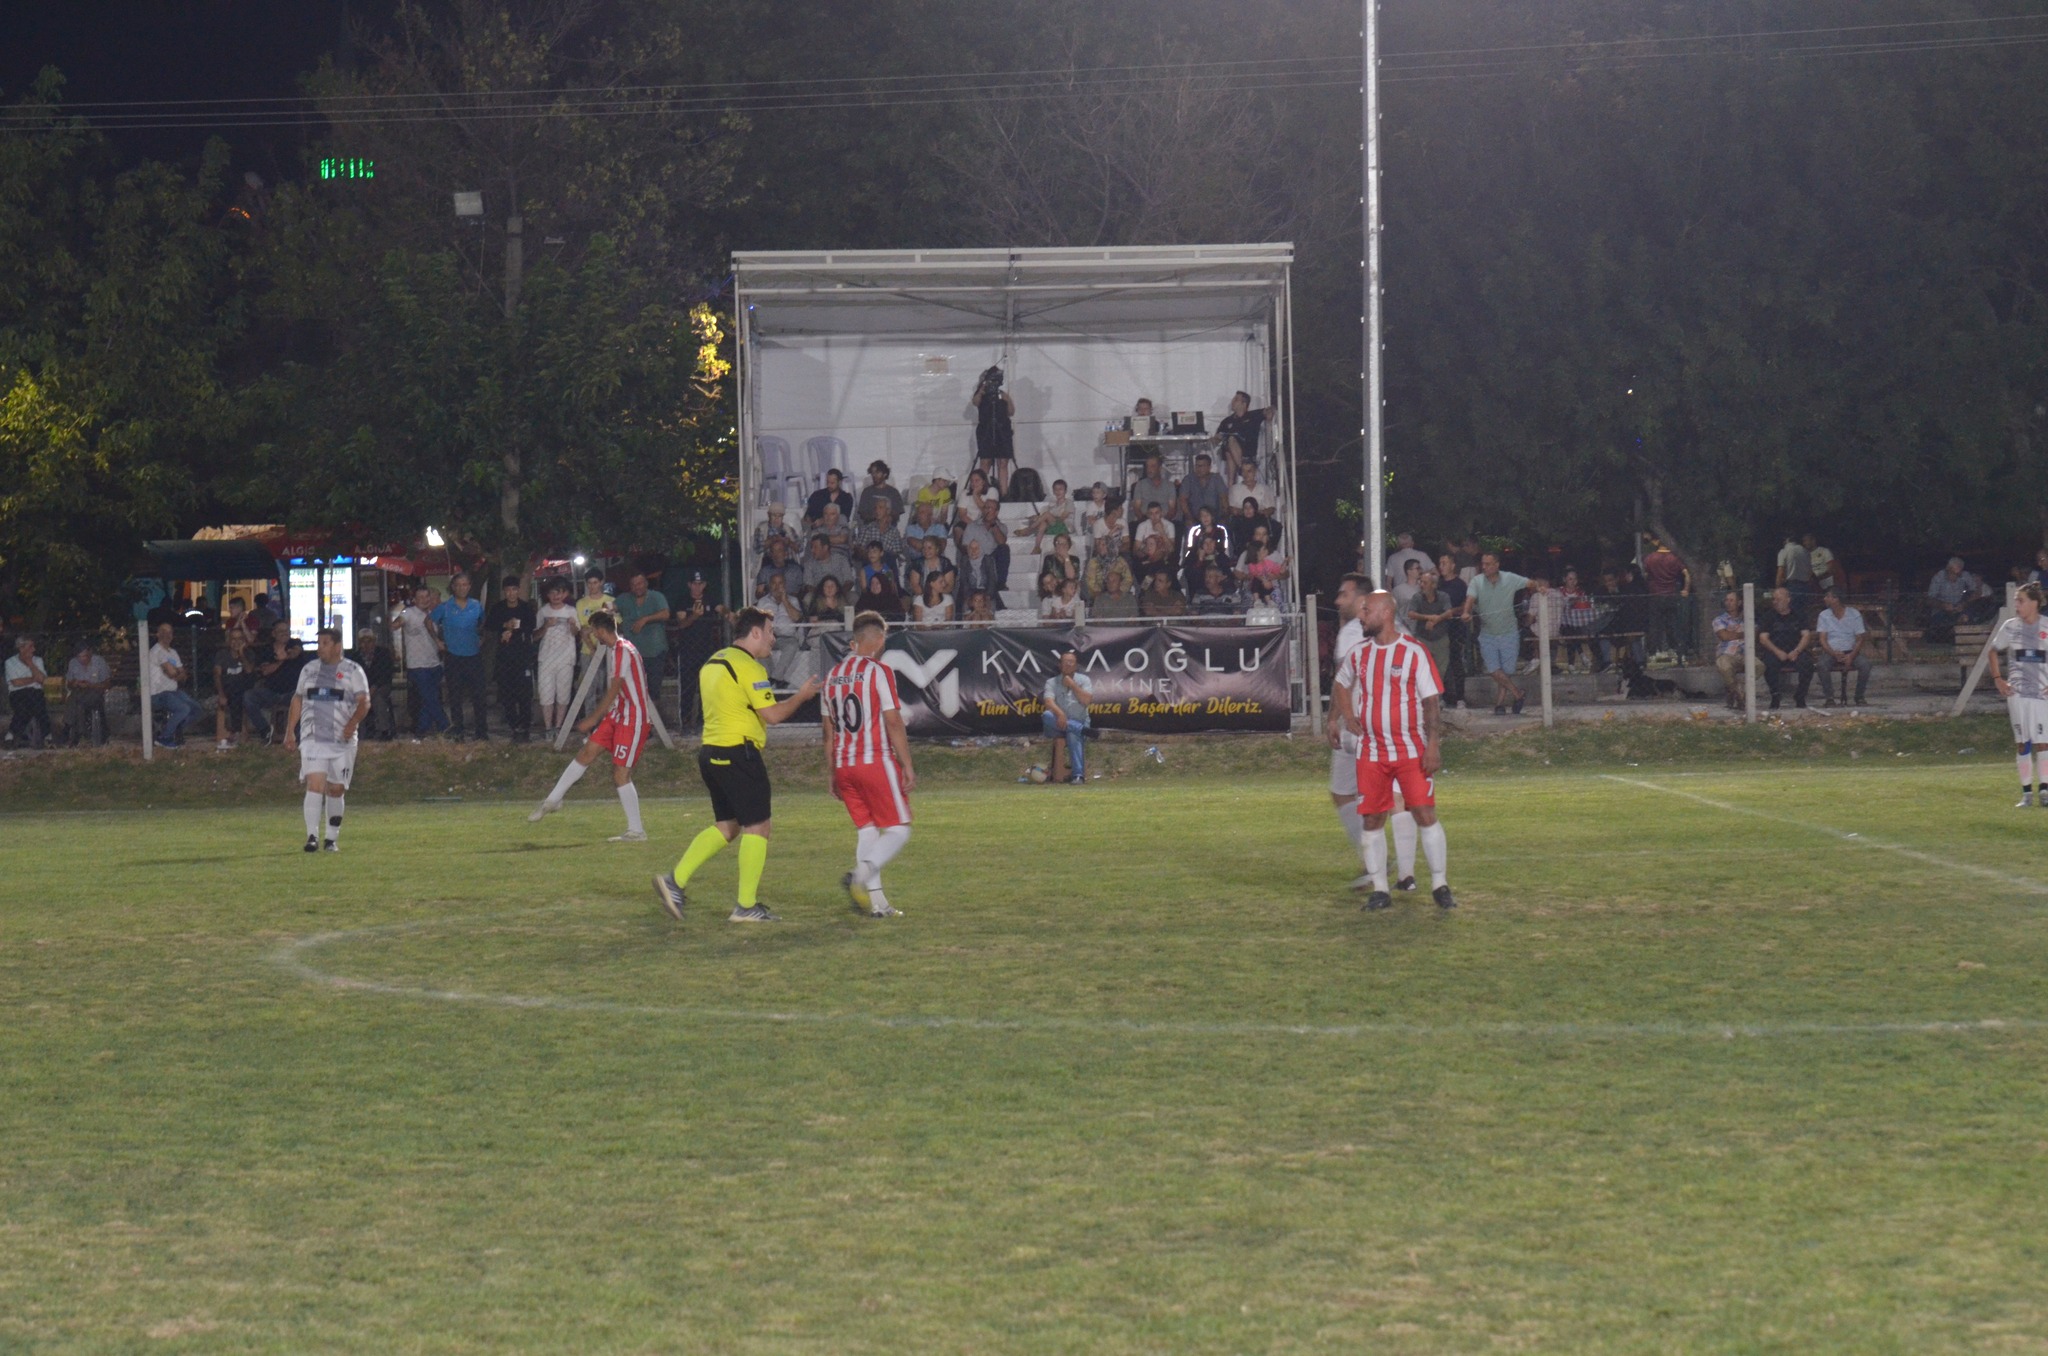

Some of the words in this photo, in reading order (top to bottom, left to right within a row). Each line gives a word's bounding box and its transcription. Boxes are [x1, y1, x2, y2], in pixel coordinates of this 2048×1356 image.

[831, 692, 862, 733] 10
[976, 697, 1009, 716] Tüm
[1127, 696, 1202, 717] Başarılar
[1205, 696, 1263, 716] Dileriz.
[614, 744, 628, 760] 15
